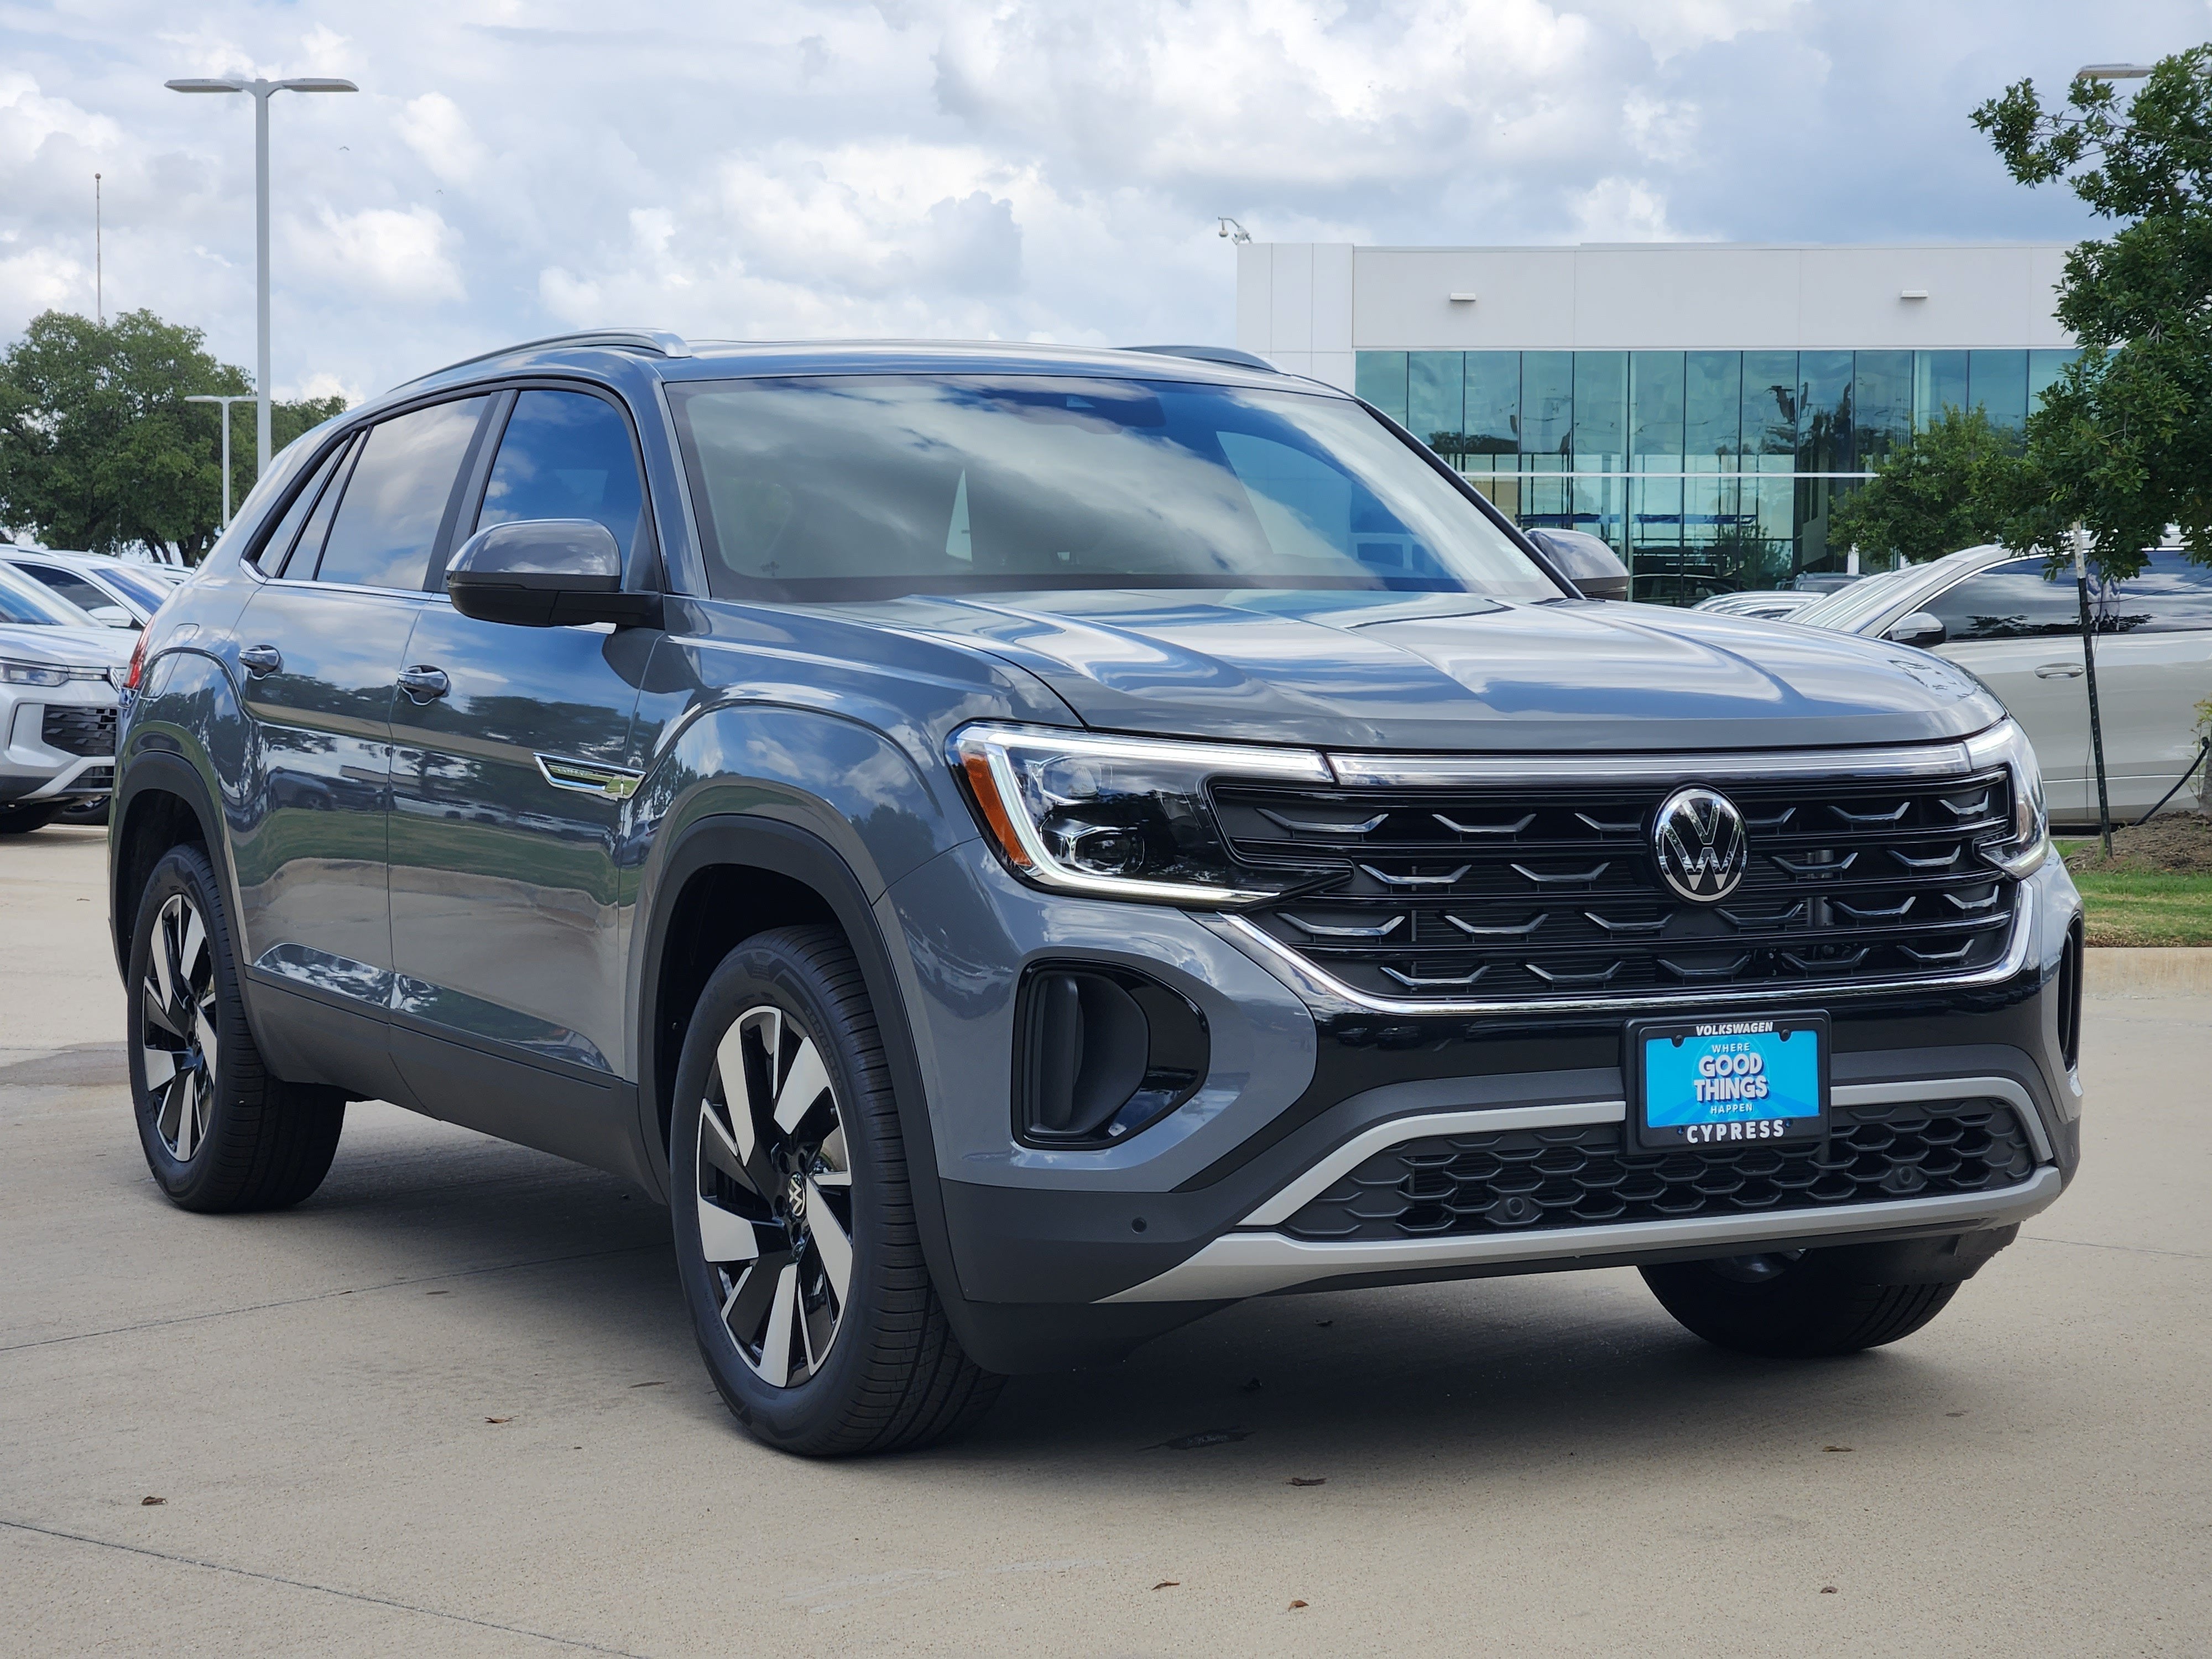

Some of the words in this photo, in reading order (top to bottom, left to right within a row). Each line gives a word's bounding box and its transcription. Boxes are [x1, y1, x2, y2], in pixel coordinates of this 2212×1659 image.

[1695, 1021, 1773, 1036] VOLKSWAGEN
[1712, 1042, 1750, 1053] WHERE
[1699, 1052, 1763, 1077] GOOD
[1694, 1075, 1768, 1102] THINGS
[1710, 1103, 1753, 1114] HAPPEN
[1687, 1119, 1784, 1144] CYPRESS
